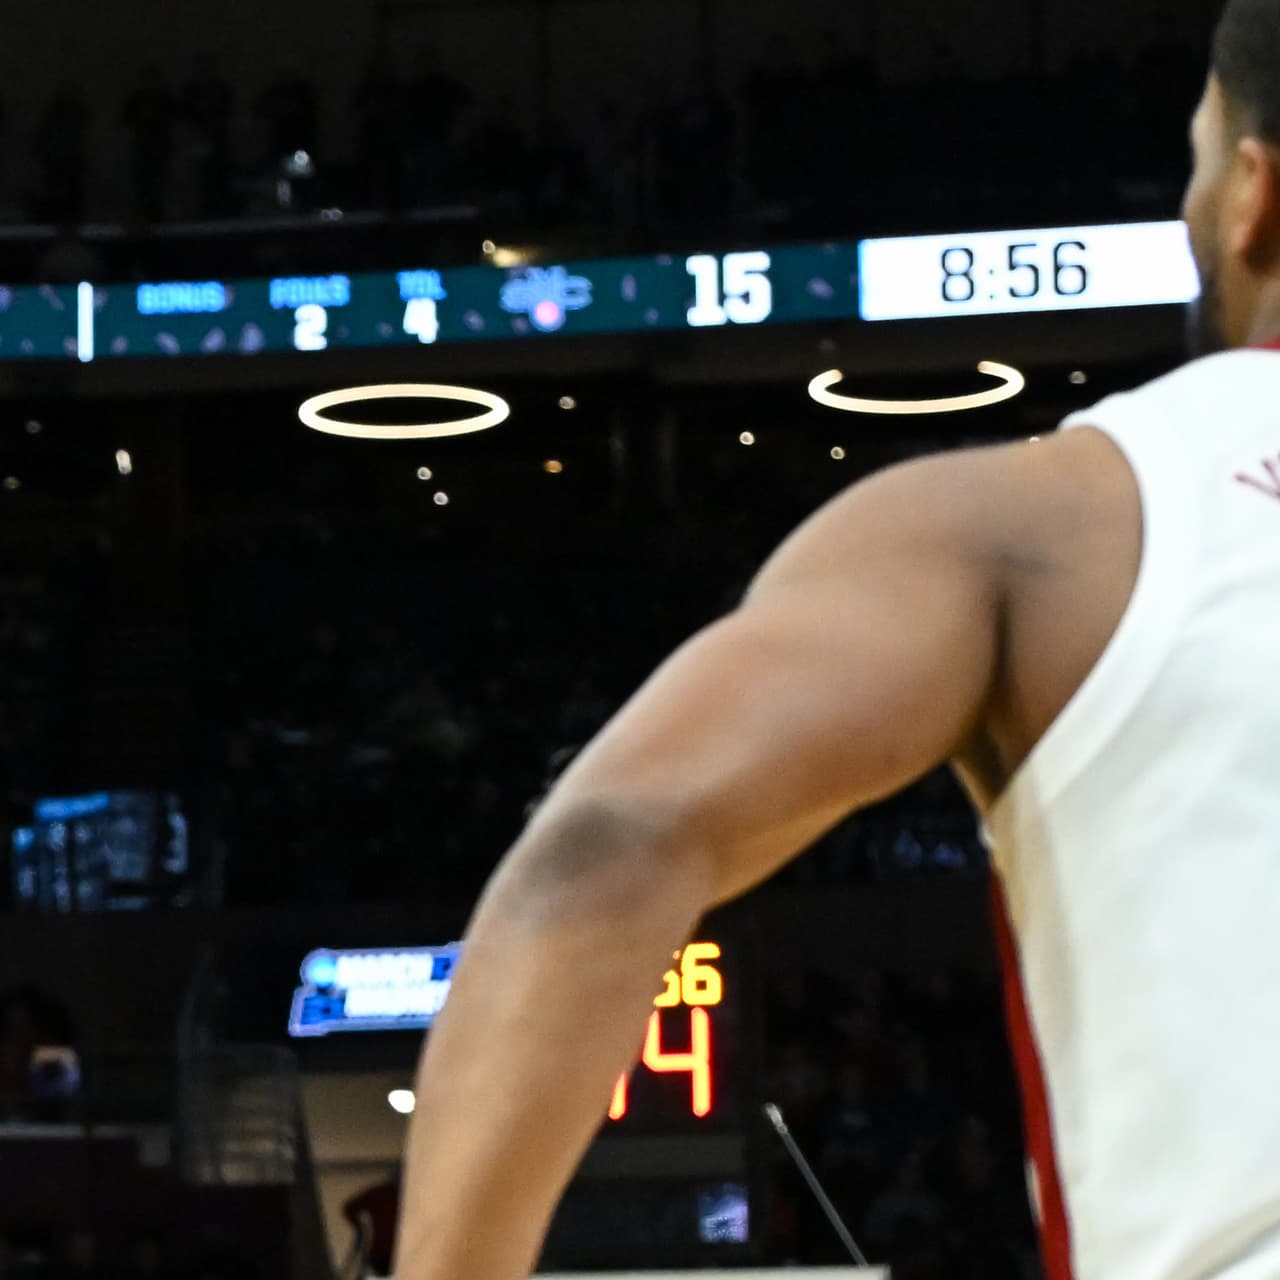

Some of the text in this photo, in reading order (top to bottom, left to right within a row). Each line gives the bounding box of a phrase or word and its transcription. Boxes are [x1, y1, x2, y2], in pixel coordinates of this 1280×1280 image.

[686, 251, 772, 326] 15
[941, 241, 1087, 302] 8:56
[294, 298, 438, 350] 2 4
